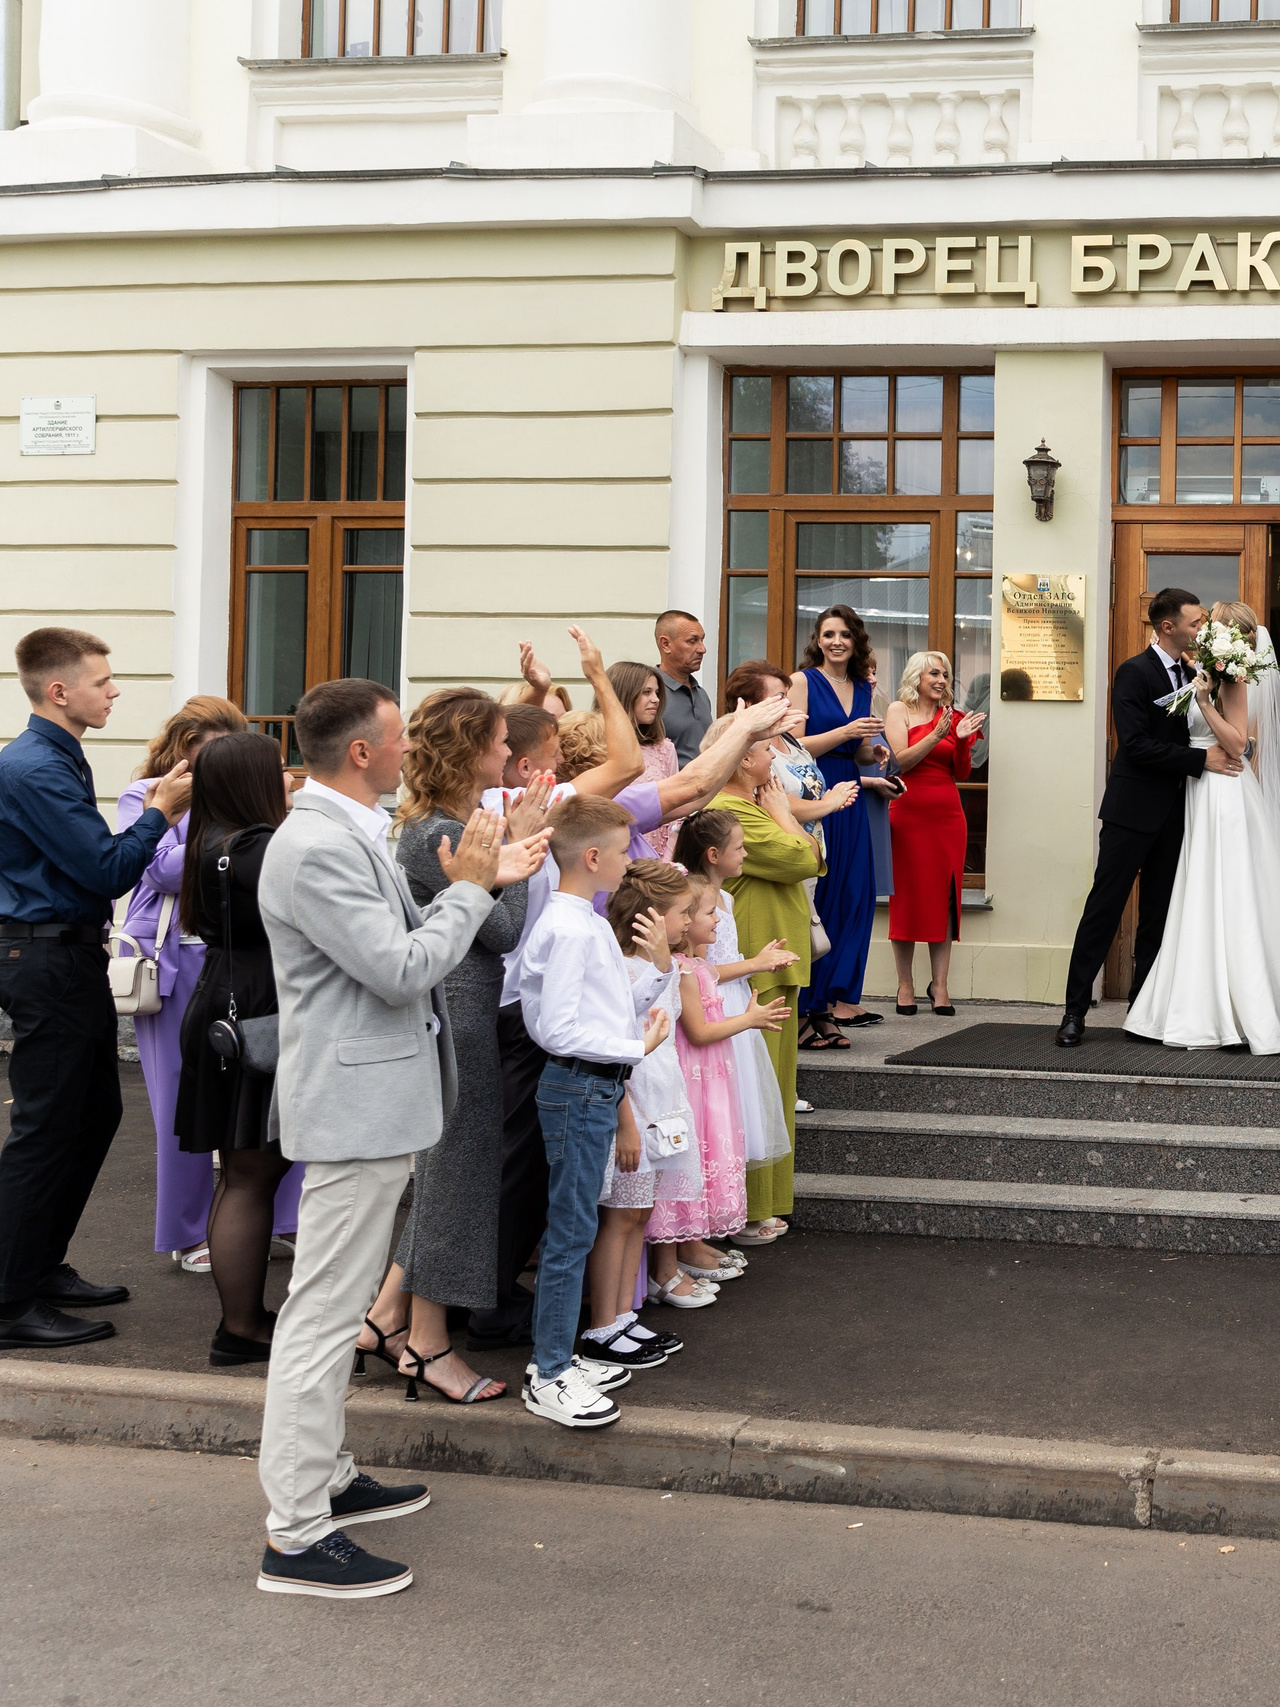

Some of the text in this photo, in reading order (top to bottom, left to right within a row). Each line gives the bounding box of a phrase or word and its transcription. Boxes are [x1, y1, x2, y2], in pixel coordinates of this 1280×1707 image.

[711, 235, 1038, 312] ДВОРЕЦ
[1014, 592, 1076, 602] Отдел ЗАГС
[1014, 601, 1073, 609] Администрации
[1042, 608, 1080, 616] Новгорода
